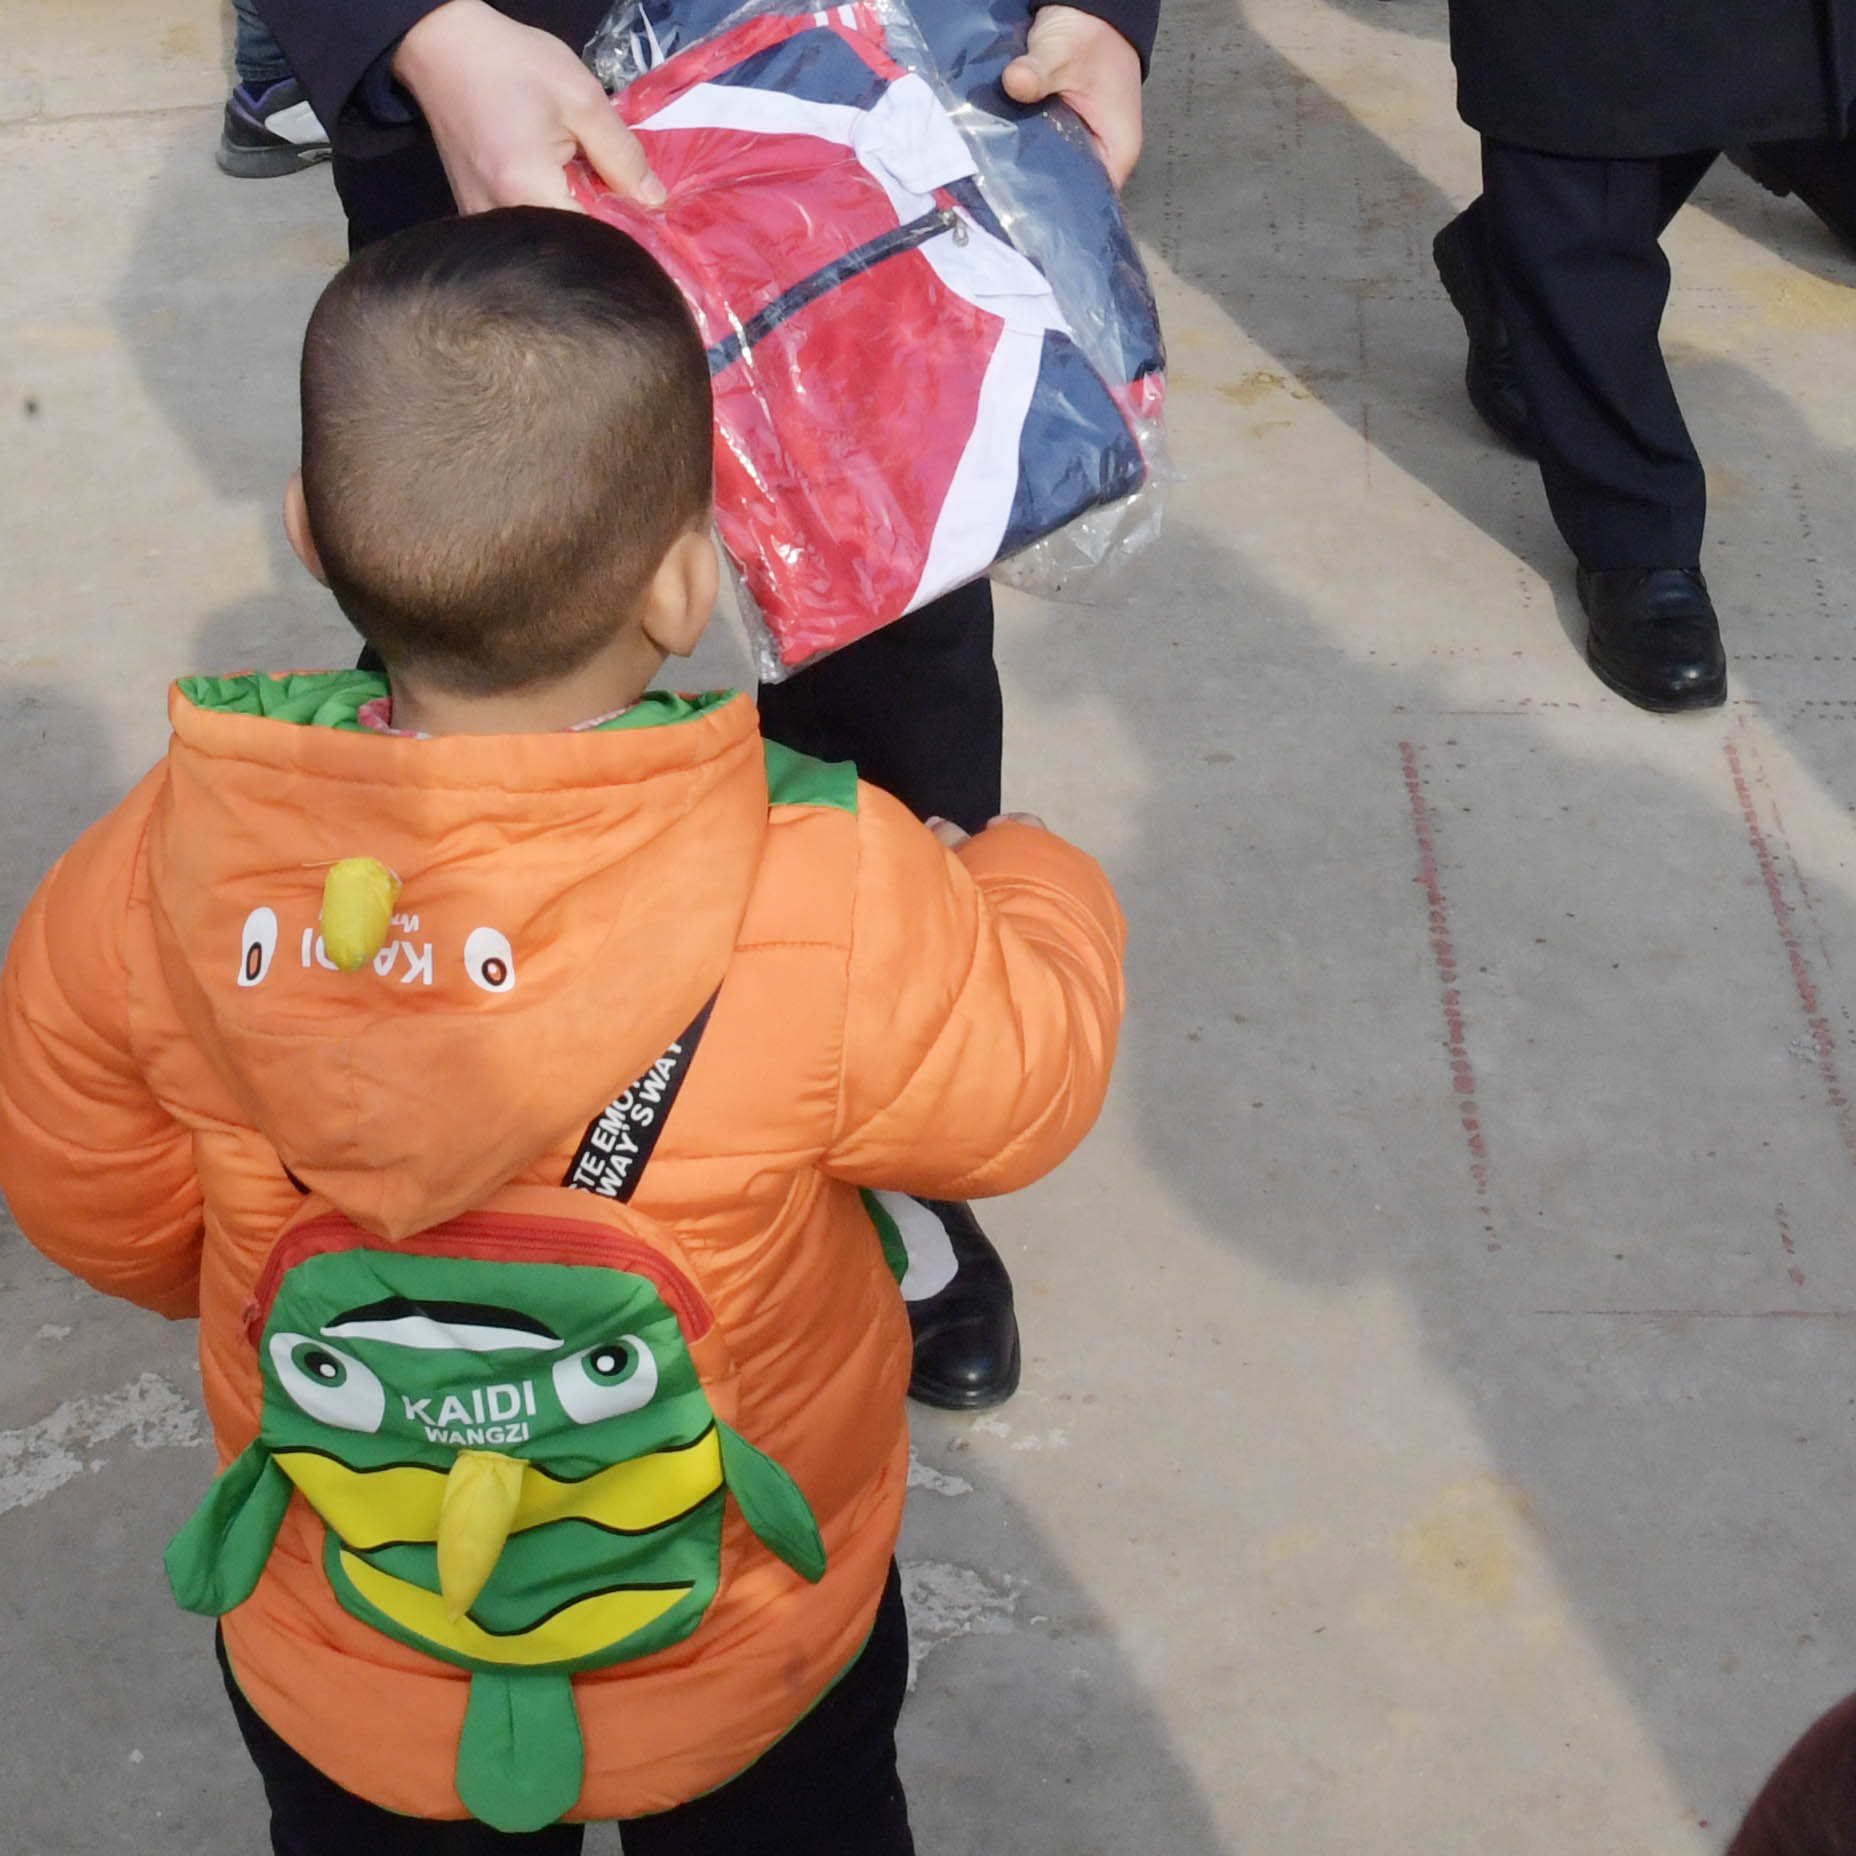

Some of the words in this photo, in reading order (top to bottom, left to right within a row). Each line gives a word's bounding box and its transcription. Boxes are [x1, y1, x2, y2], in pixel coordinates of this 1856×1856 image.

[591, 1080, 641, 1153] EMO
[401, 1380, 537, 1427] KAIDI
[424, 1421, 530, 1446] WANGZI
